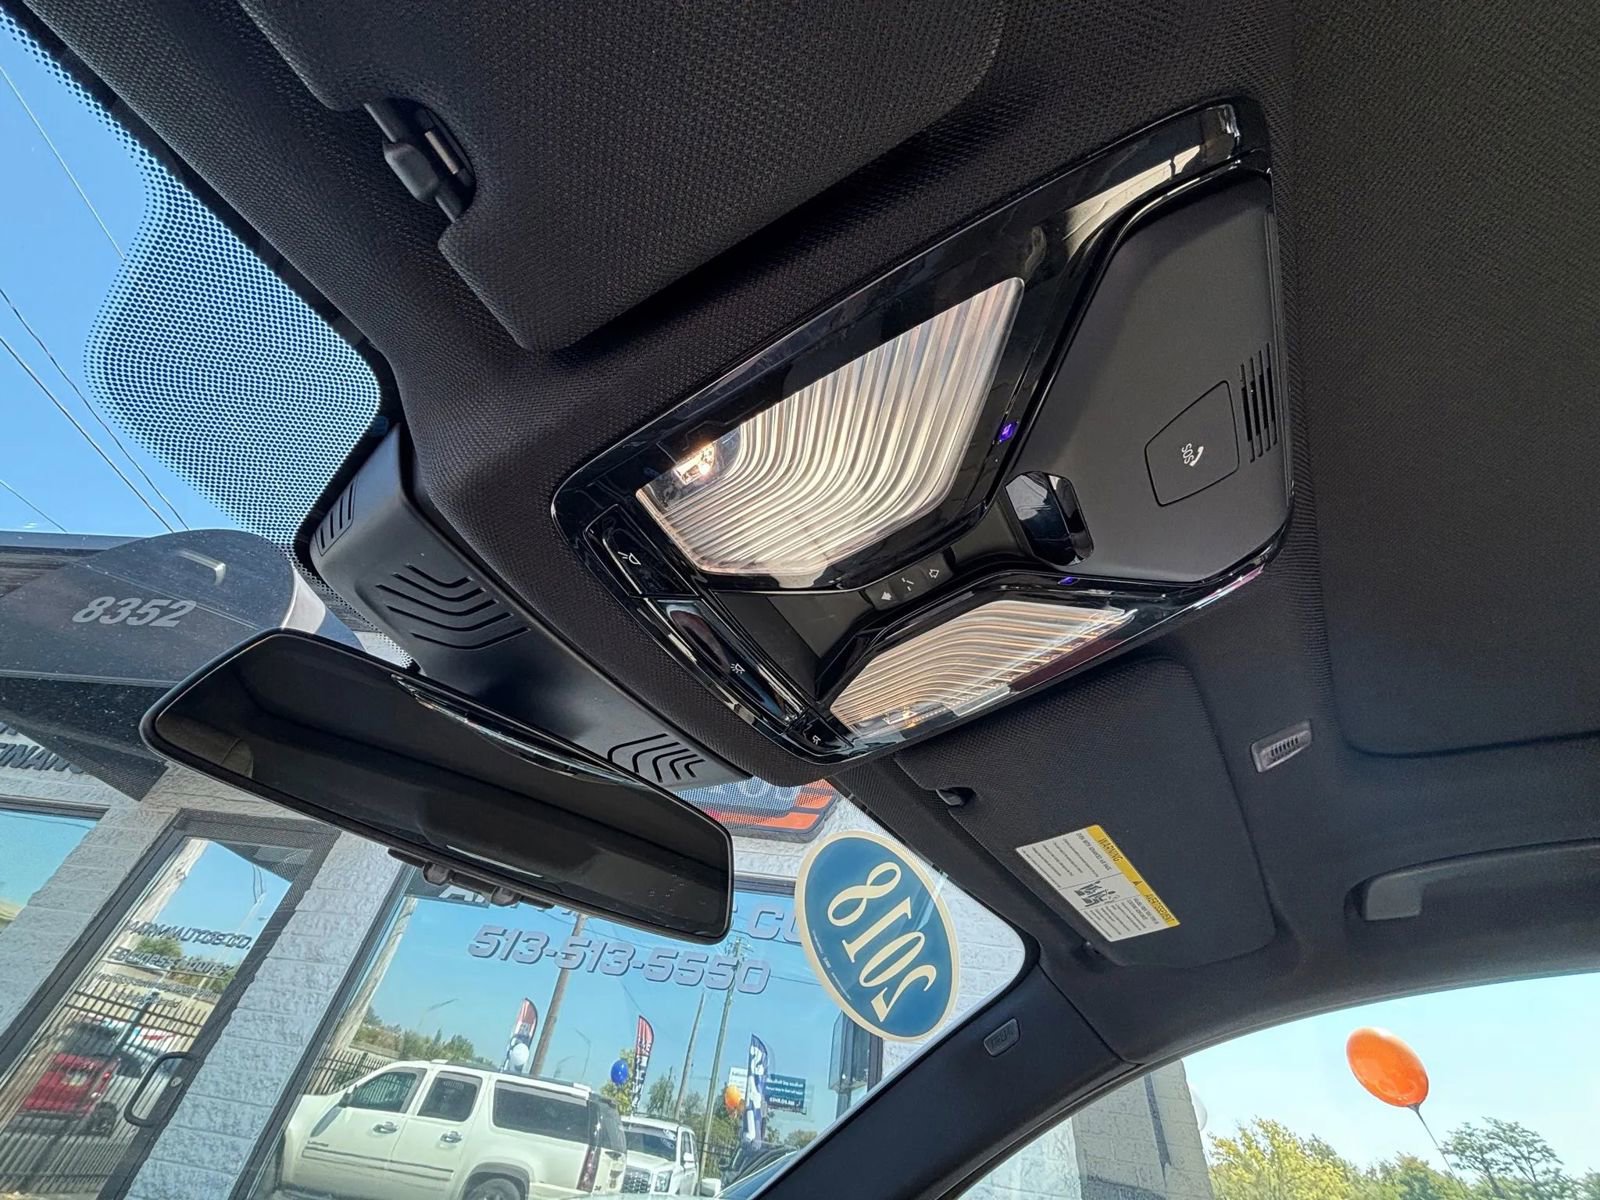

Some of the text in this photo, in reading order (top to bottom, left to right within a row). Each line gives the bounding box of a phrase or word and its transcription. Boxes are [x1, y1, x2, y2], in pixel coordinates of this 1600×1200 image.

[1181, 443, 1195, 465] SOS
[71, 596, 197, 628] 8352
[1098, 838, 1123, 862] WARNING
[467, 924, 771, 994] 513-513-5550
